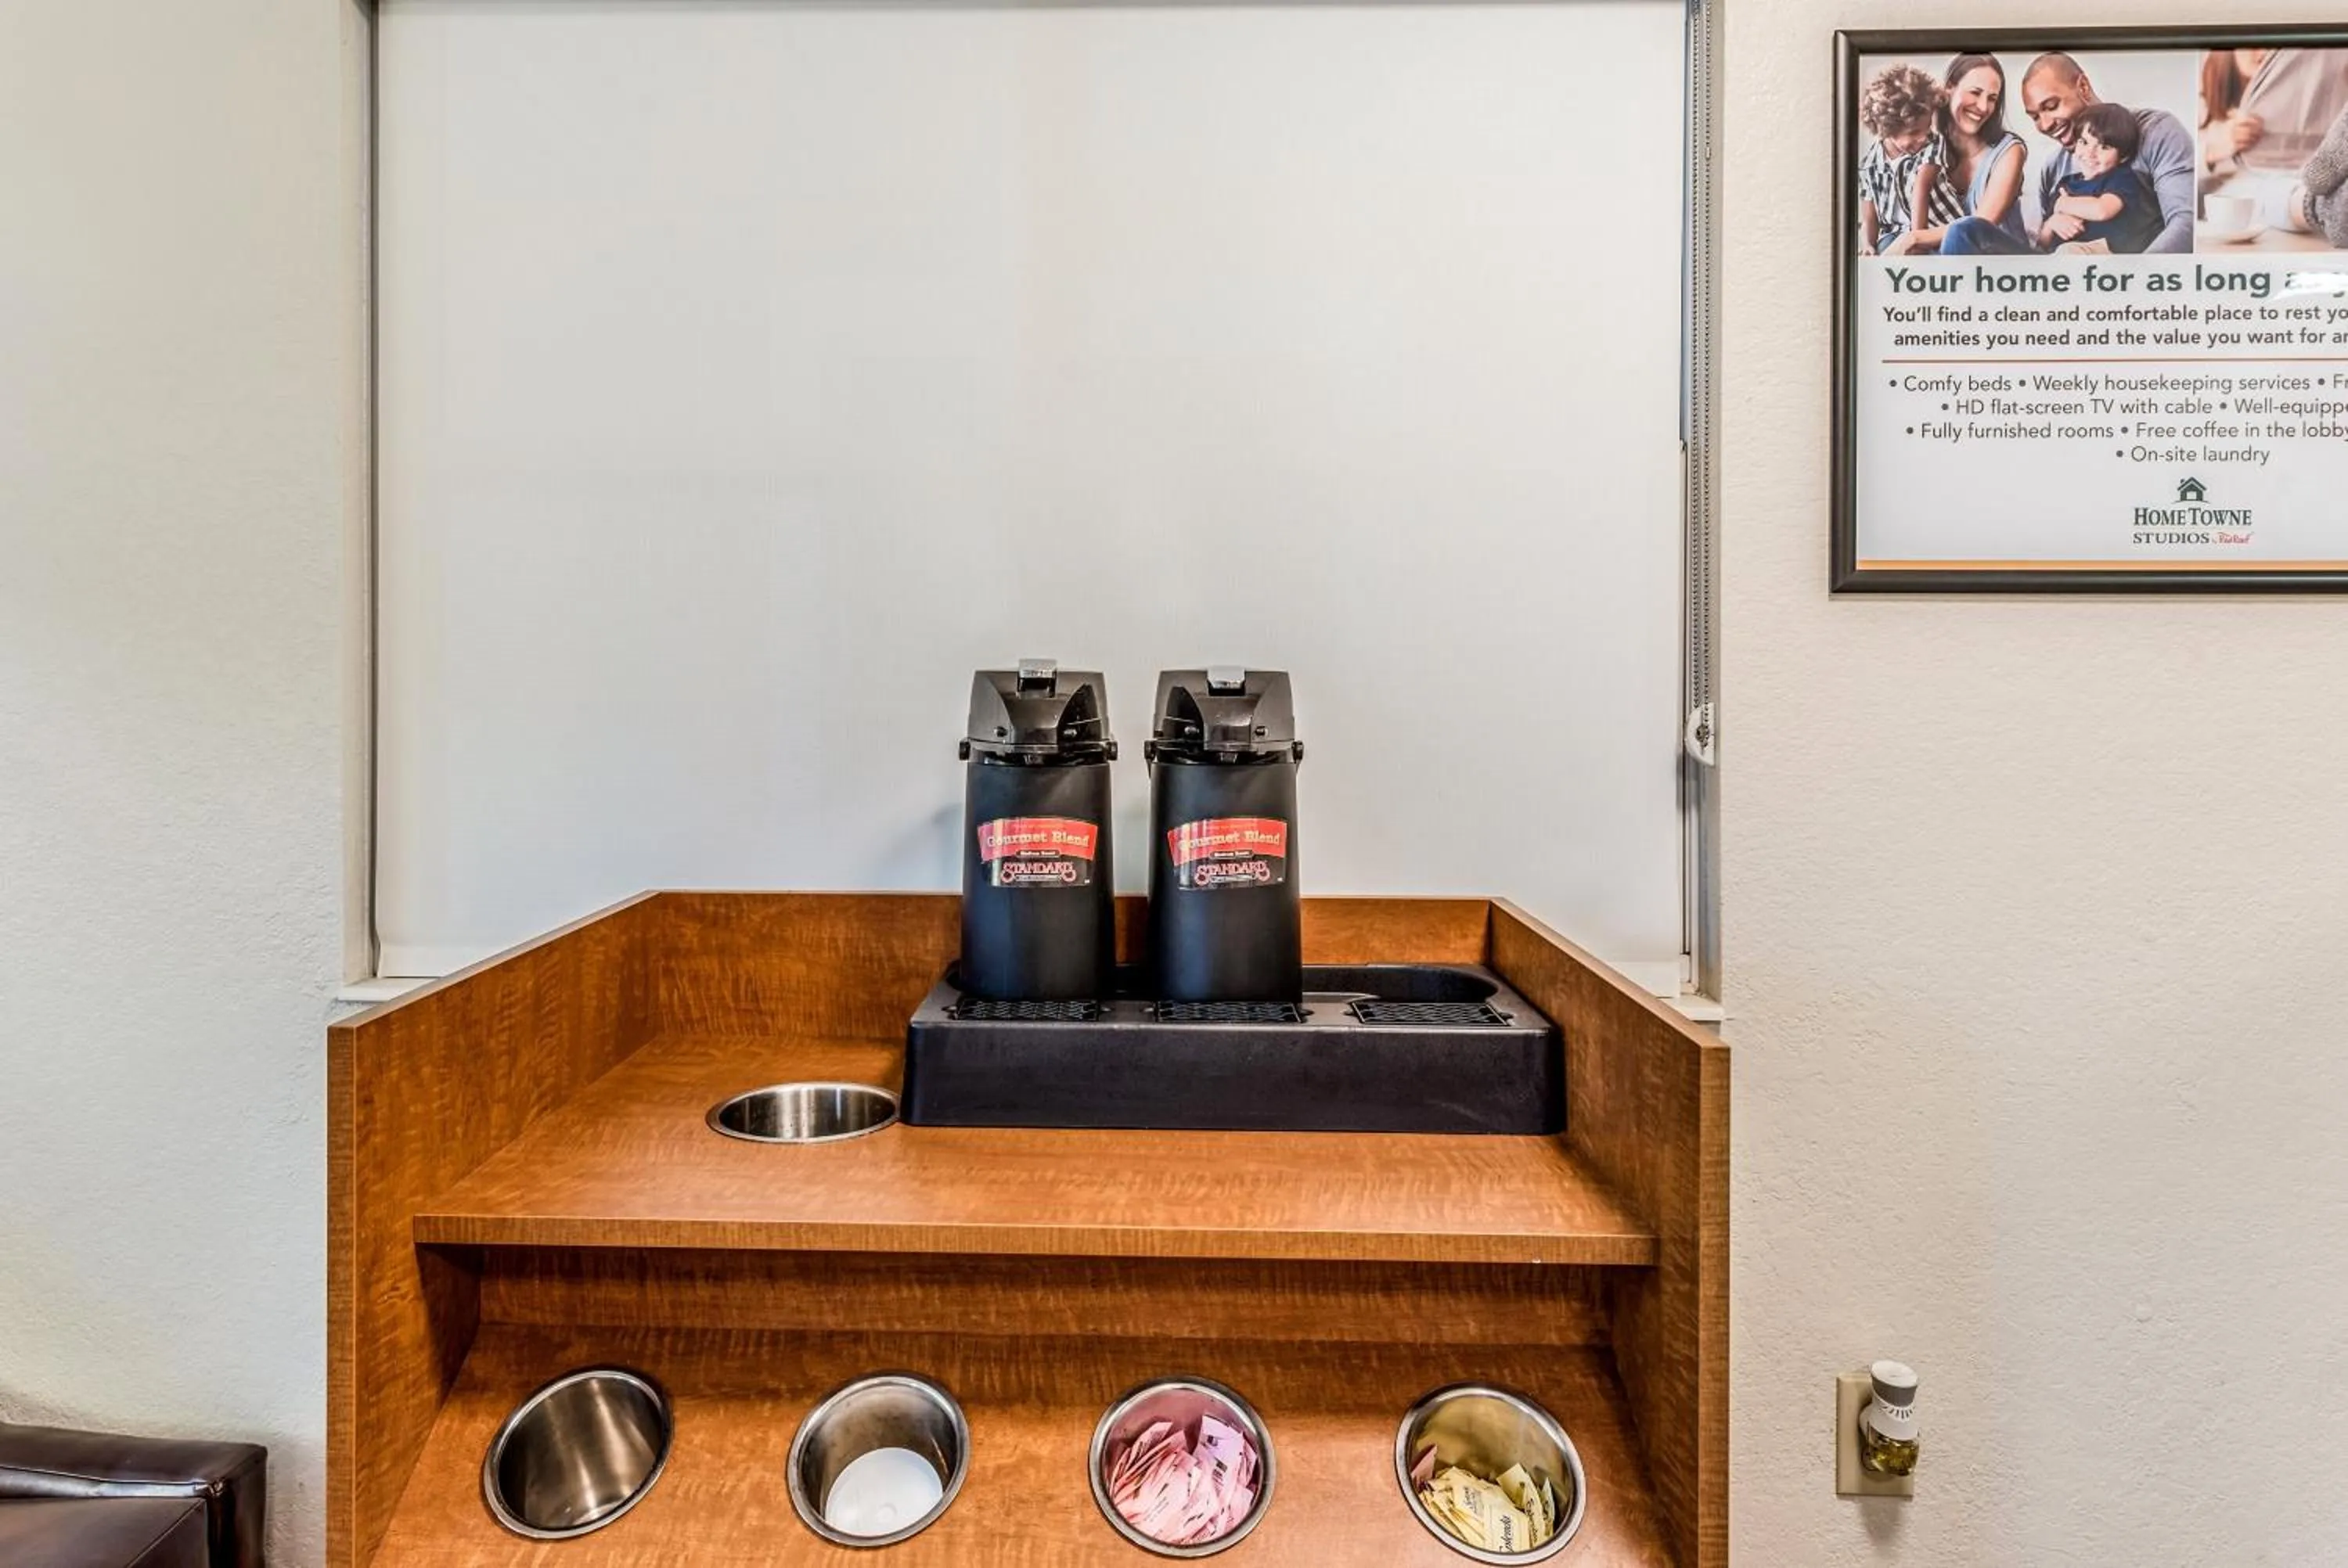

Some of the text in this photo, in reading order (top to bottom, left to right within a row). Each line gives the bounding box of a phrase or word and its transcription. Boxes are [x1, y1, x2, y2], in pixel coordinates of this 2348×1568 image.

[1885, 267, 1964, 293] Your
[1975, 265, 2070, 293] home
[2083, 264, 2134, 292] for
[2146, 272, 2182, 292] as
[2196, 264, 2271, 298] long
[1882, 305, 1931, 322] You'll
[1937, 305, 1972, 322] find
[1979, 310, 1989, 322] a
[1994, 305, 2040, 322] clean
[2047, 305, 2080, 322] and
[2086, 304, 2198, 322] comfortable
[2206, 304, 2253, 324] place
[2259, 306, 2279, 320] to
[2285, 306, 2321, 320] rest
[1893, 330, 1980, 346] amenities
[1986, 334, 2019, 349] you
[2026, 329, 2070, 345] need
[2076, 329, 2109, 345] and
[2116, 329, 2146, 344] the
[2152, 328, 2201, 344] value
[2207, 333, 2241, 348] you
[2247, 330, 2294, 343] want
[2299, 327, 2326, 343] for
[1903, 375, 1962, 396] Comfy
[1969, 376, 2011, 392] beds
[2033, 375, 2098, 396] Weekly
[2105, 374, 2232, 396] housekeeping
[2239, 374, 2310, 391] services
[1957, 399, 1984, 415] HD
[1990, 398, 2083, 415] flat-screen
[2090, 397, 2115, 414] TV
[2120, 397, 2158, 414] with
[2165, 397, 2213, 414] cable
[1921, 422, 1962, 443] Fully
[1968, 422, 2051, 438] furnished
[2058, 426, 2113, 438] rooms
[2137, 423, 2176, 437] Free
[2183, 421, 2238, 437] coffee
[2245, 421, 2260, 437] in
[2267, 421, 2296, 437] the
[2130, 444, 2270, 466] On-site laundry
[2133, 532, 2209, 544] STUDIOS
[987, 830, 1089, 847] Gourmet Blend
[1244, 830, 1280, 845] Blend
[1001, 861, 1076, 883] STANDARD
[1194, 861, 1270, 886] STANDARD
